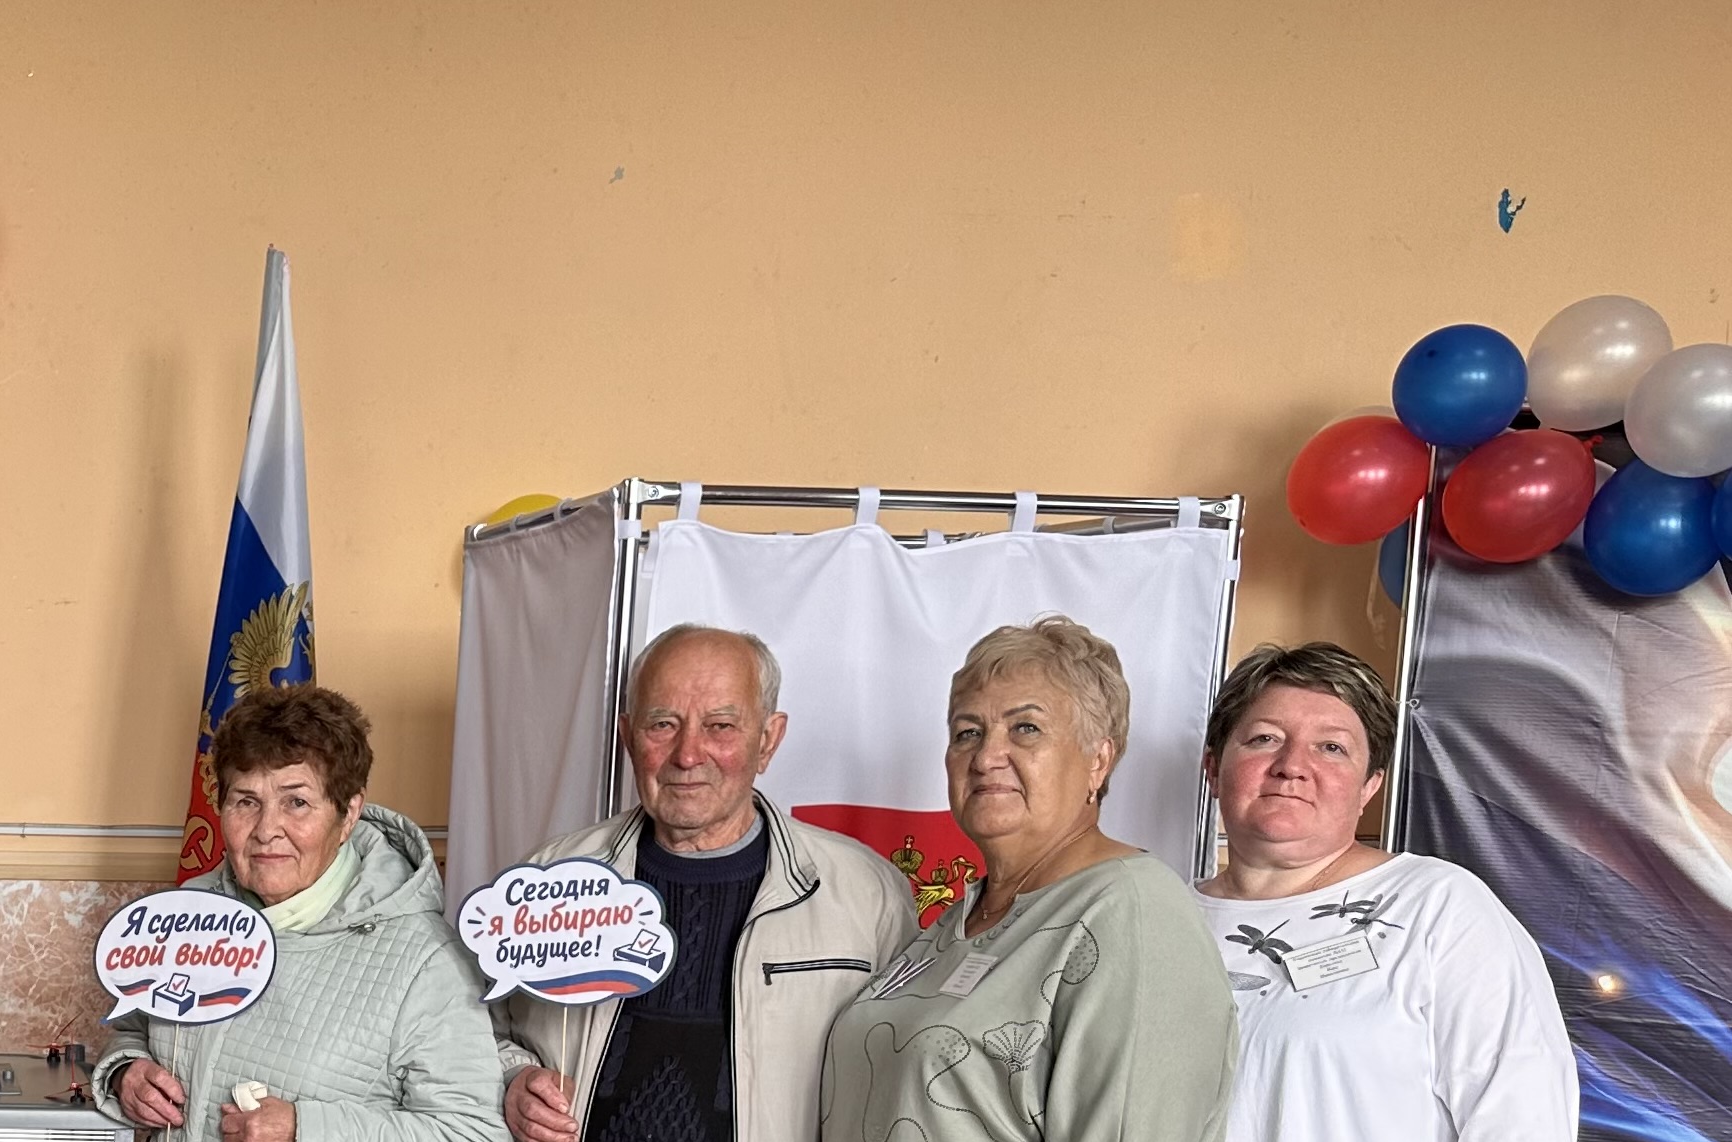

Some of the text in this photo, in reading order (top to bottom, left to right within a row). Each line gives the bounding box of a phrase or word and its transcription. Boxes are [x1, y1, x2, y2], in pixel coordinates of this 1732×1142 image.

[505, 877, 610, 906] Сегодня
[121, 906, 257, 944] Я сделал(а)
[488, 901, 634, 938] я выбираю
[105, 936, 267, 976] свой выбор!
[496, 935, 602, 969] будущее!
